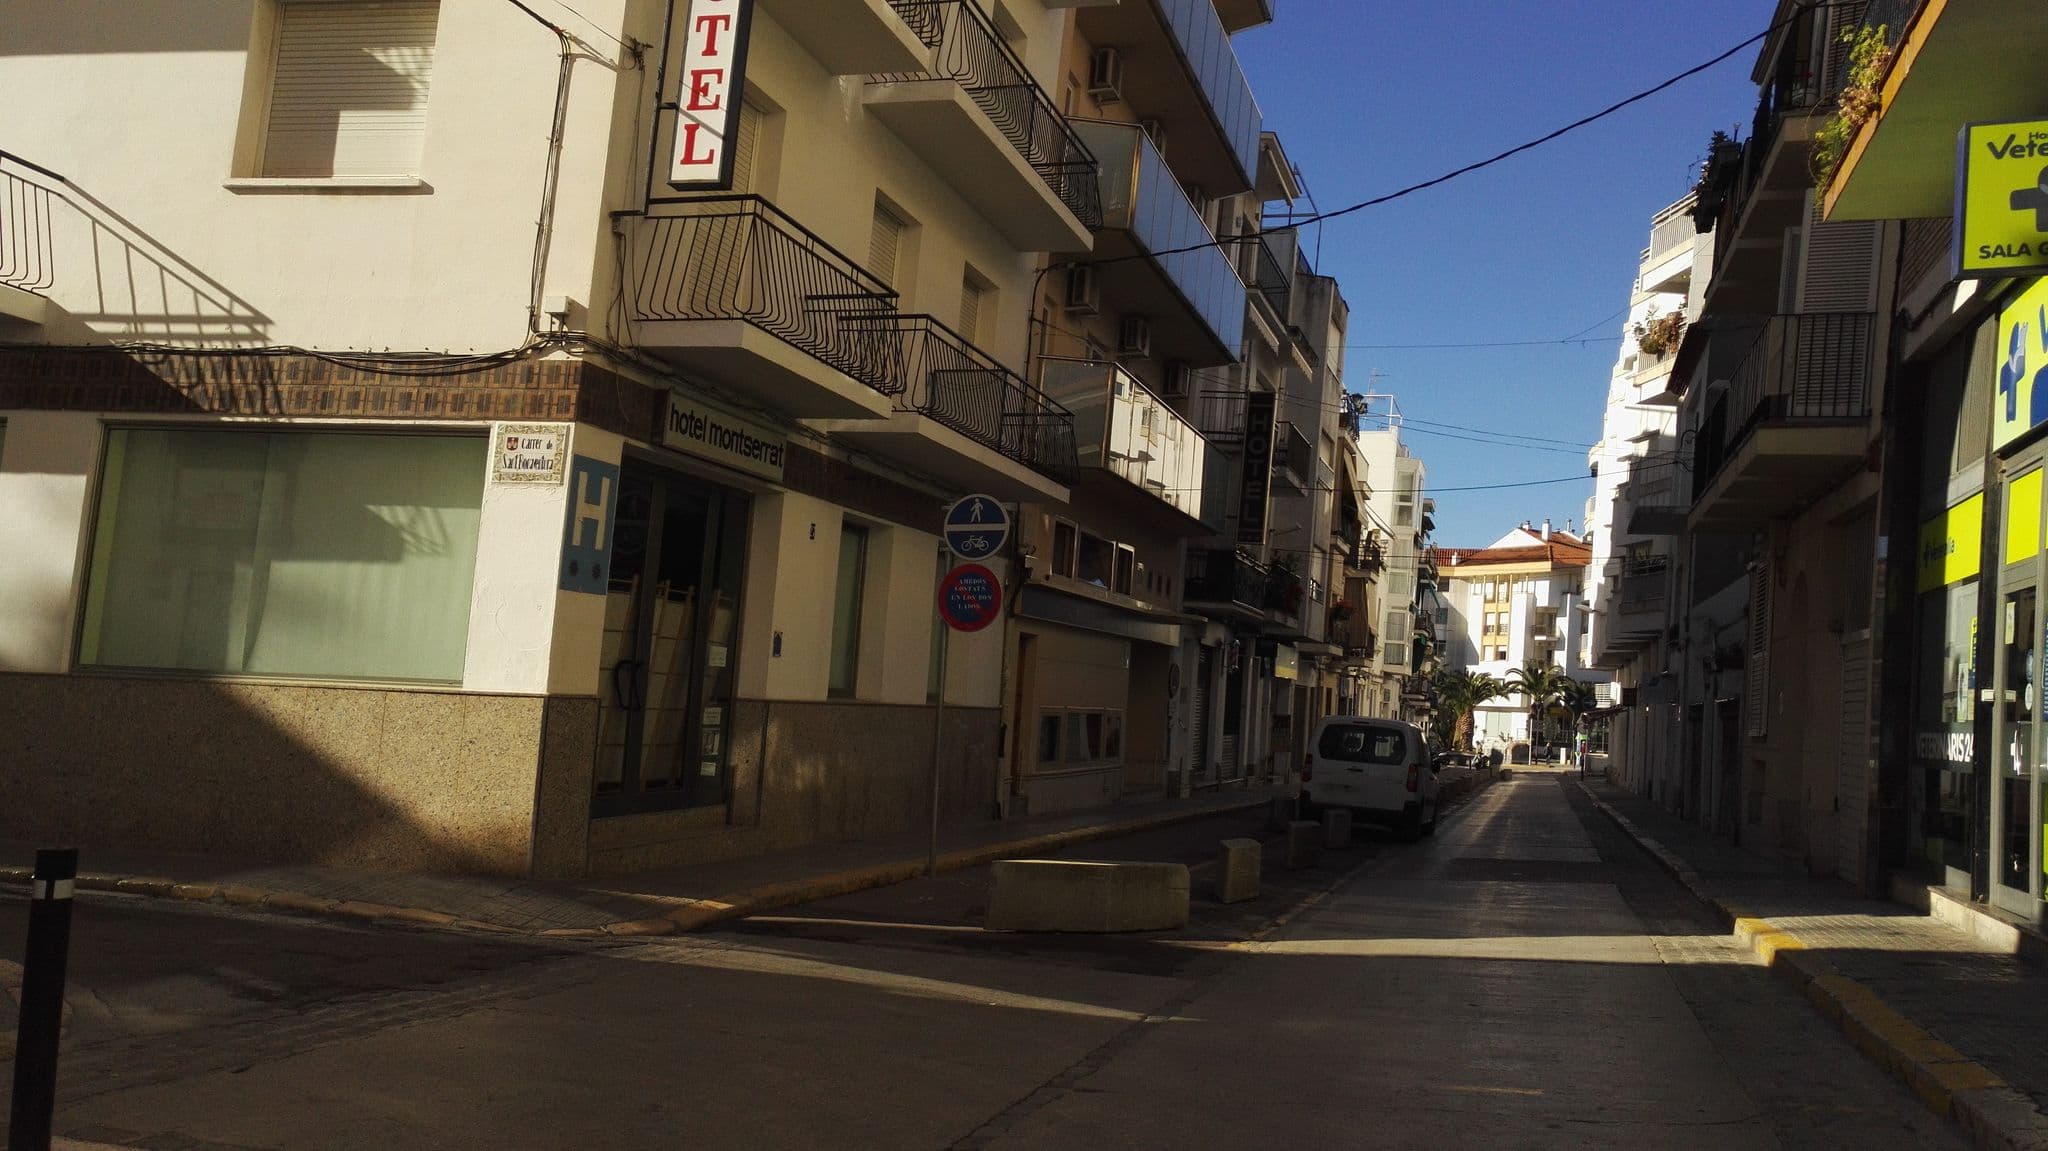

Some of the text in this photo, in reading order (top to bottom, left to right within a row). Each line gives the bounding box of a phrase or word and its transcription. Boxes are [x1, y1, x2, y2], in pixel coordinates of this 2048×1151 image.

[680, 0, 731, 165] TEL
[1979, 243, 2031, 259] SALA
[669, 403, 784, 468] hotel montserrat
[1243, 412, 1269, 522] HOTEL
[571, 470, 610, 551] H
